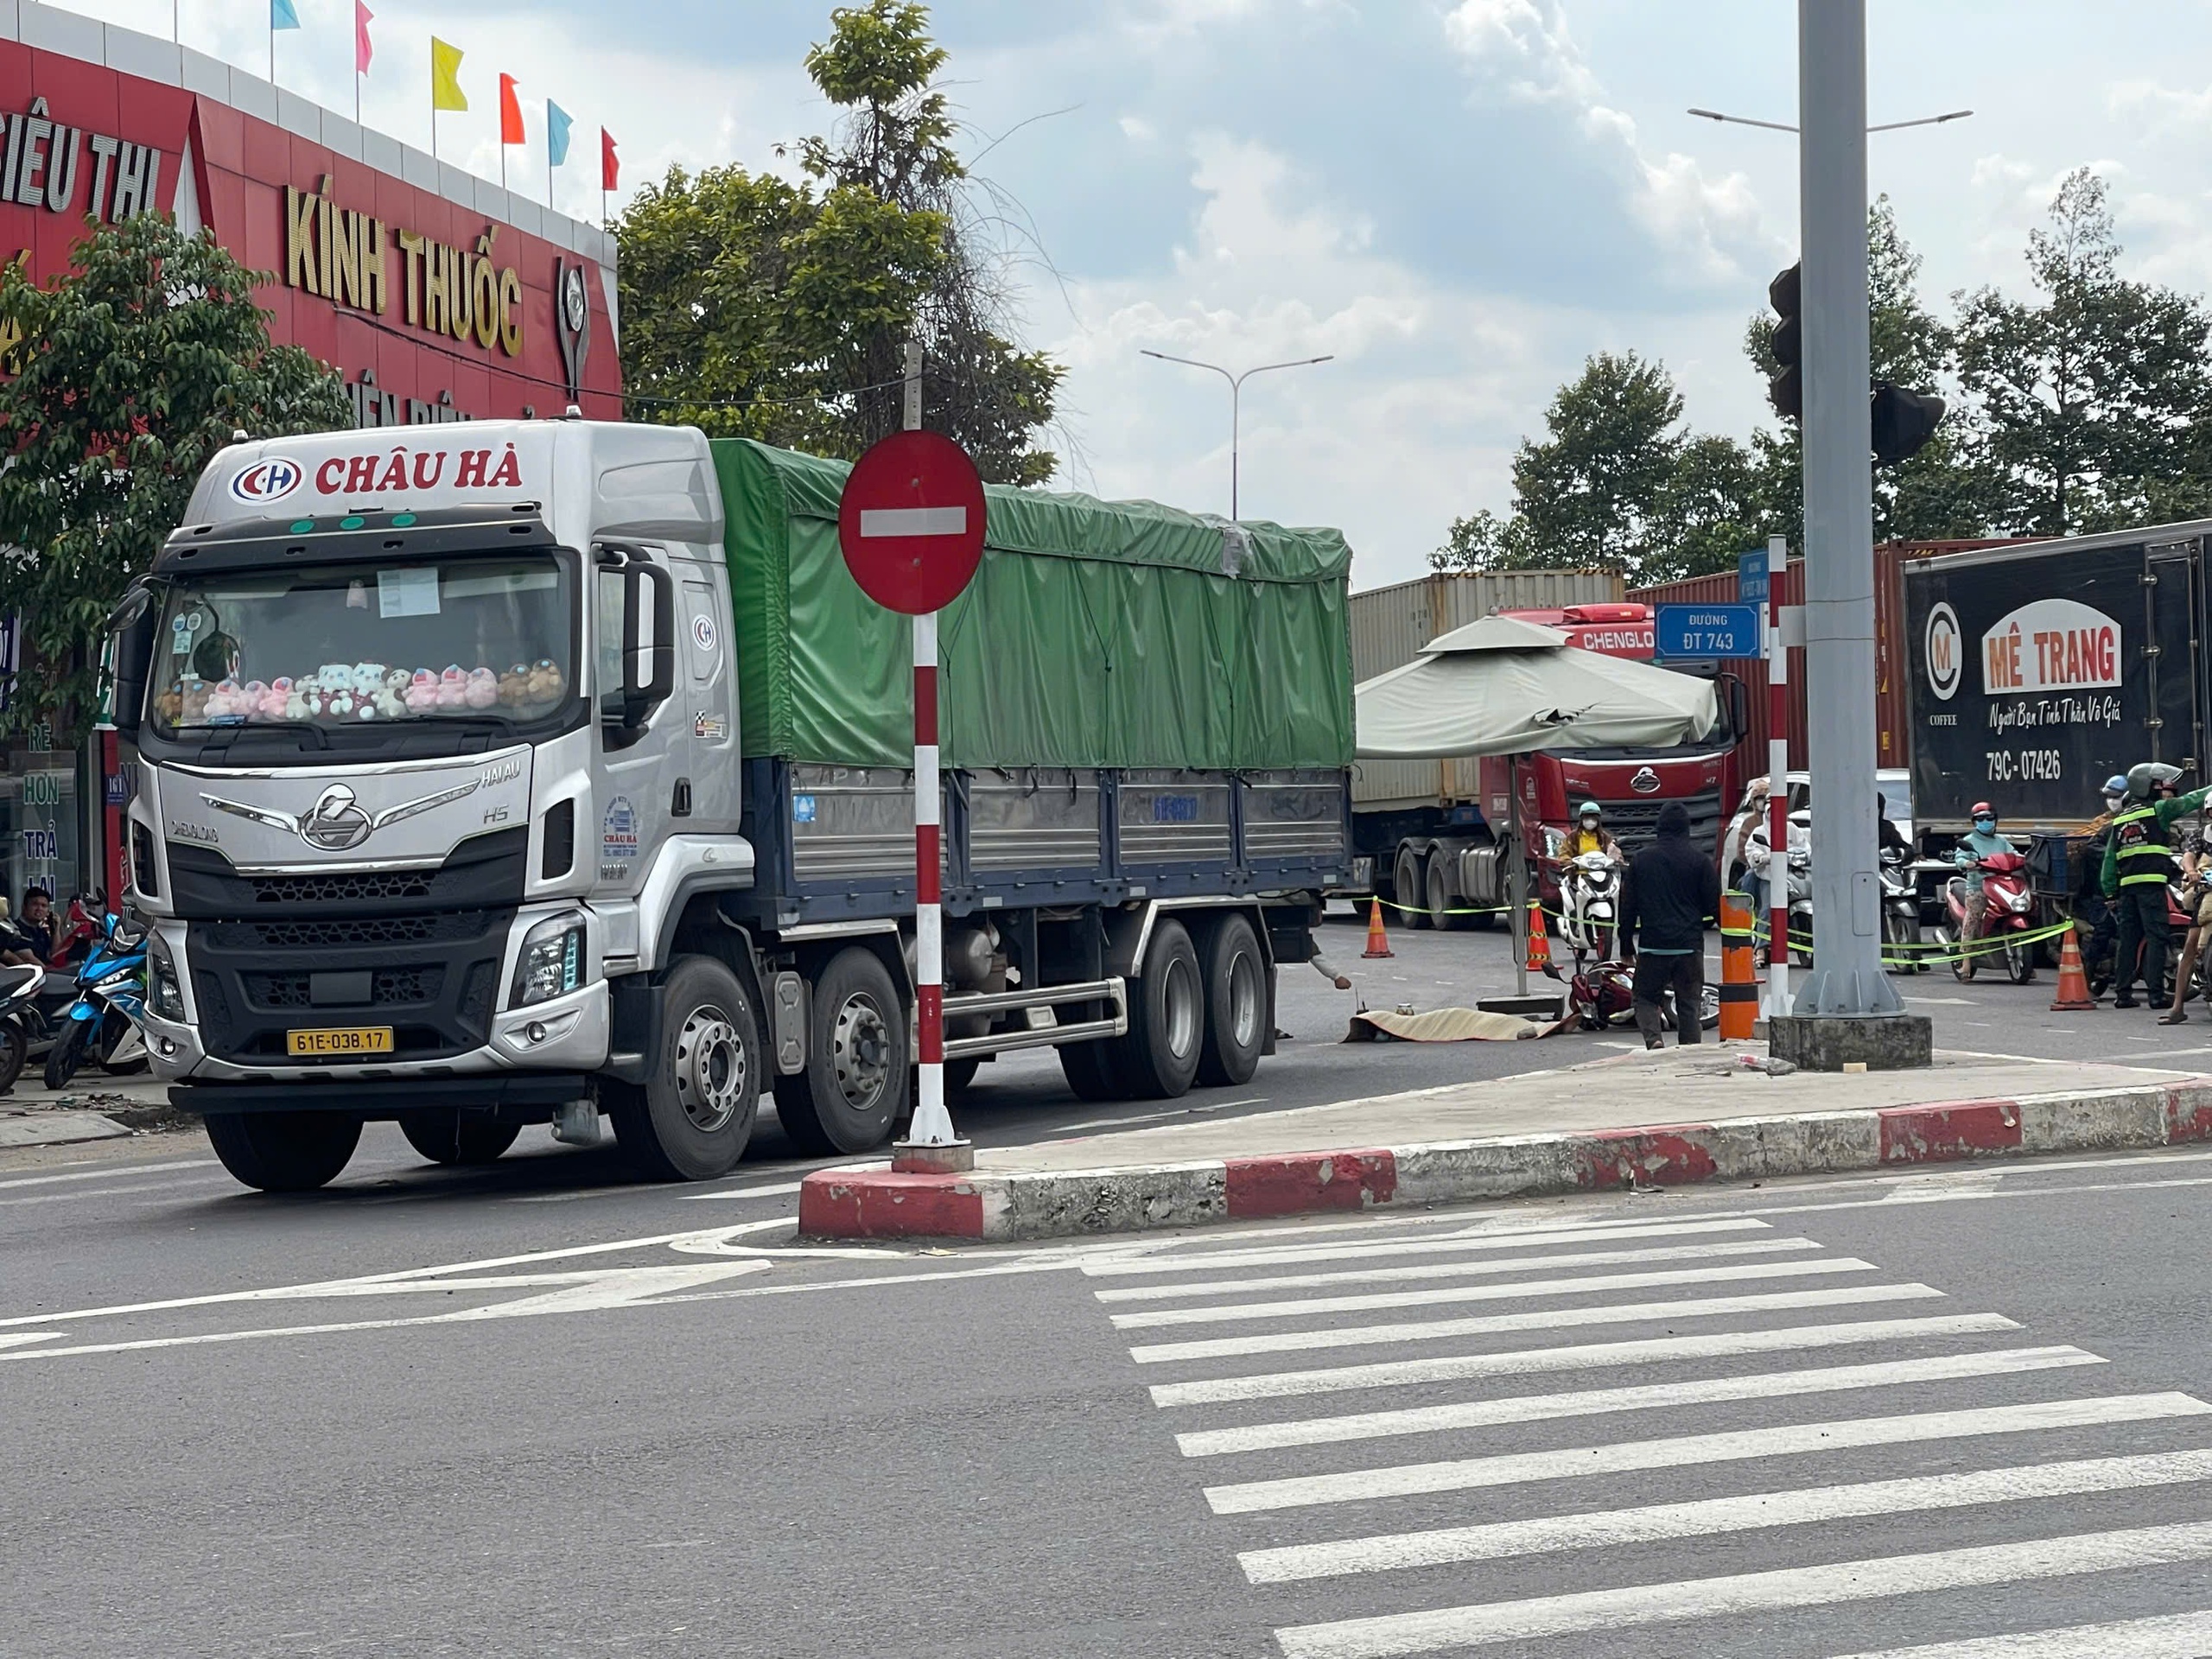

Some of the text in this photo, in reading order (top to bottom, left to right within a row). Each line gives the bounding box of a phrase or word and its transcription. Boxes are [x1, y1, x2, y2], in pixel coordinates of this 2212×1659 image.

[0, 97, 80, 213] IÊU
[284, 174, 523, 357] KÍNH THUỐC
[315, 442, 522, 494] CHÂU HÀ
[1688, 613, 1728, 626] ĐƯỜNG
[1583, 632, 1654, 649] CHENGLO
[1683, 633, 1733, 650] ĐT 743
[1988, 621, 2115, 689] MÊ TRANG
[1929, 715, 1958, 726] COFFEE
[1989, 695, 2120, 734] Người Bạn Tinh Thần Vô Giá
[23, 819, 58, 859] TRẢ
[297, 1033, 383, 1051] 61E-038.17
